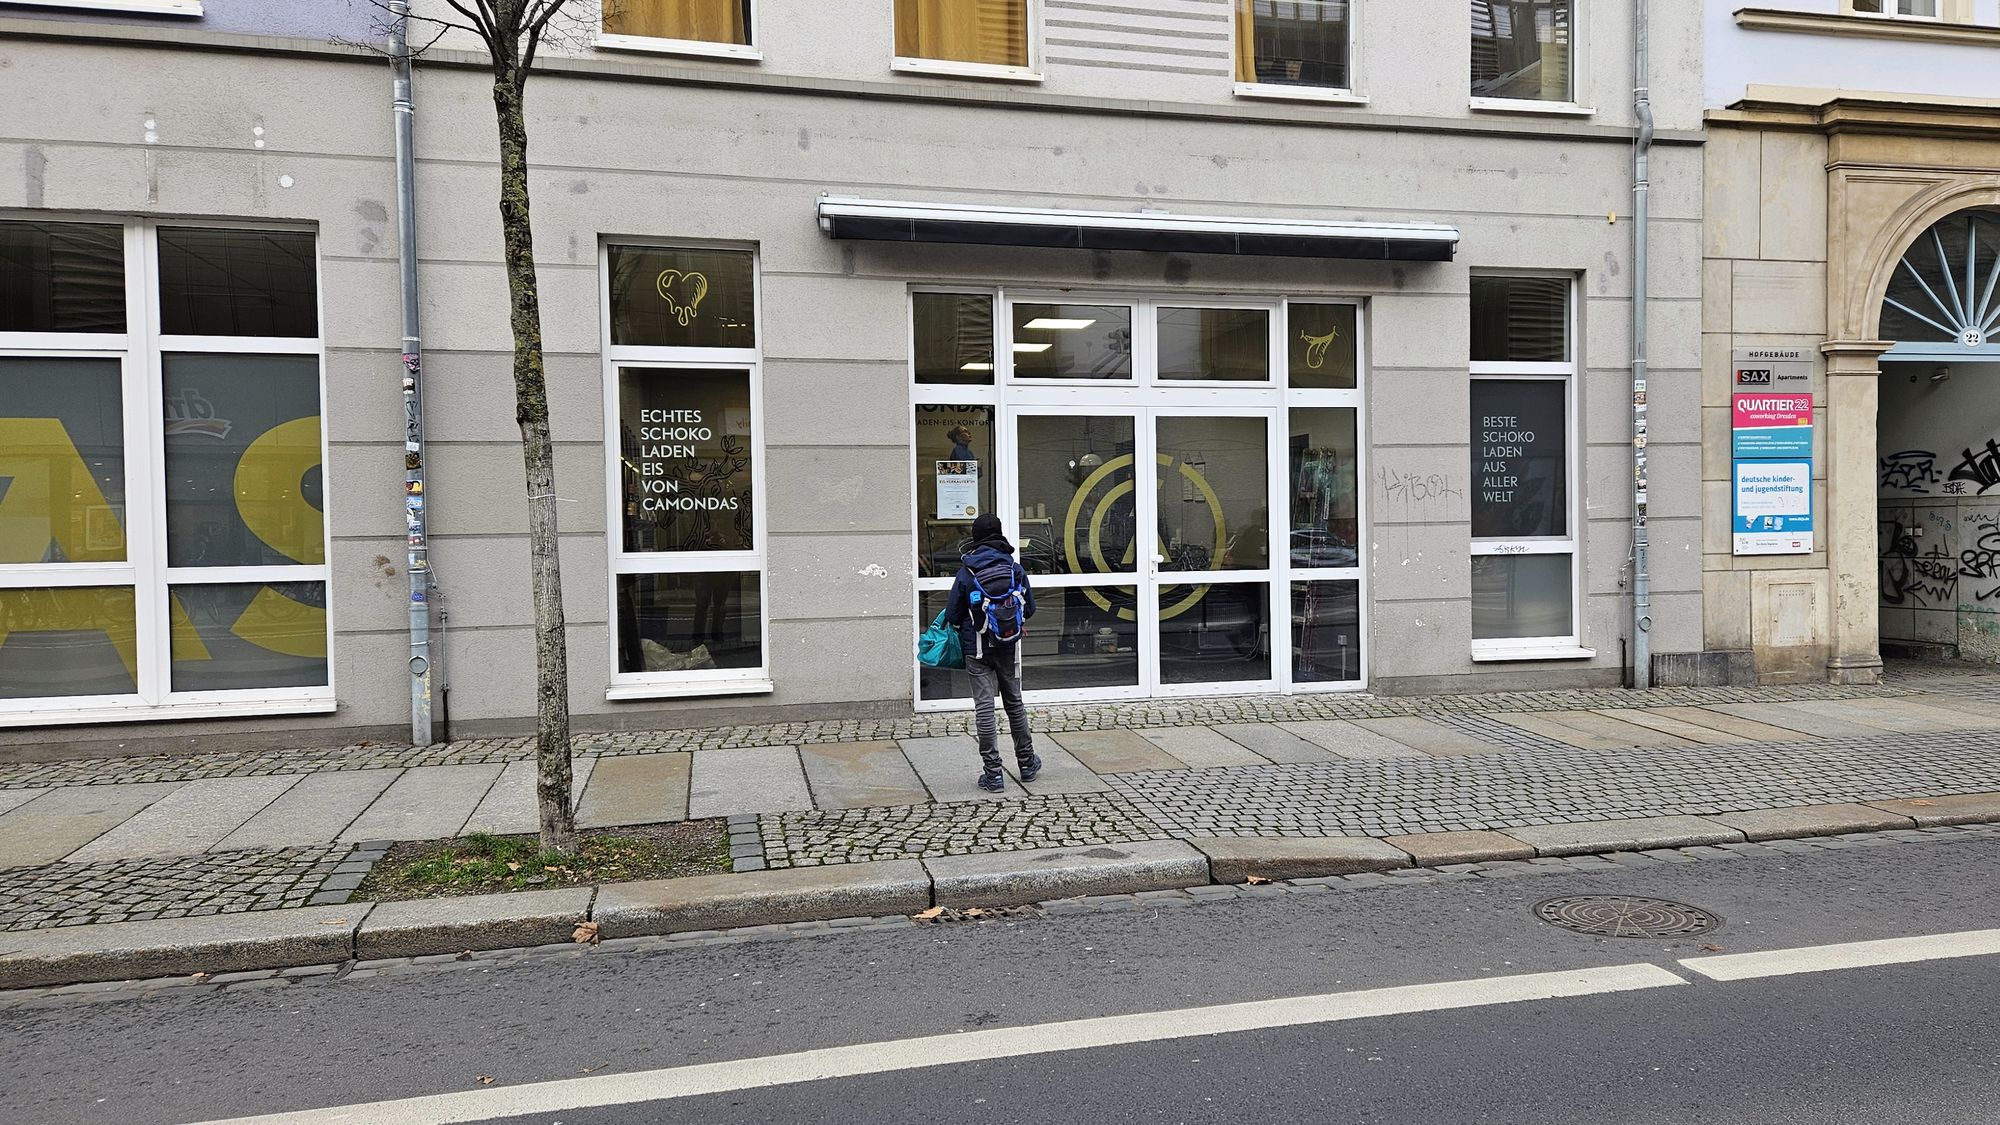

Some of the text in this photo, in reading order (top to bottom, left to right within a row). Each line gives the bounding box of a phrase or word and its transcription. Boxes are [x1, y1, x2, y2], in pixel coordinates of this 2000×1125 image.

[1965, 332, 1979, 343] 22
[1748, 350, 1800, 358] HOFGEBÄUDE
[1741, 371, 1769, 382] SAX
[640, 409, 702, 423] ECHTES
[1483, 416, 1517, 428] BESTE
[640, 427, 712, 441] SCHOKO
[1482, 431, 1535, 443] SCHOKO
[641, 445, 695, 458] LADEN
[1483, 446, 1522, 458] LADEN
[642, 462, 664, 476] EIS
[1482, 461, 1506, 473] AUS
[1483, 476, 1518, 488] ALLER
[1772, 475, 1795, 483] kinder-
[641, 480, 679, 493] VON
[1755, 485, 1804, 494] jugendstiftung
[1483, 491, 1514, 502] WELT
[642, 496, 738, 511] CAMONDAS
